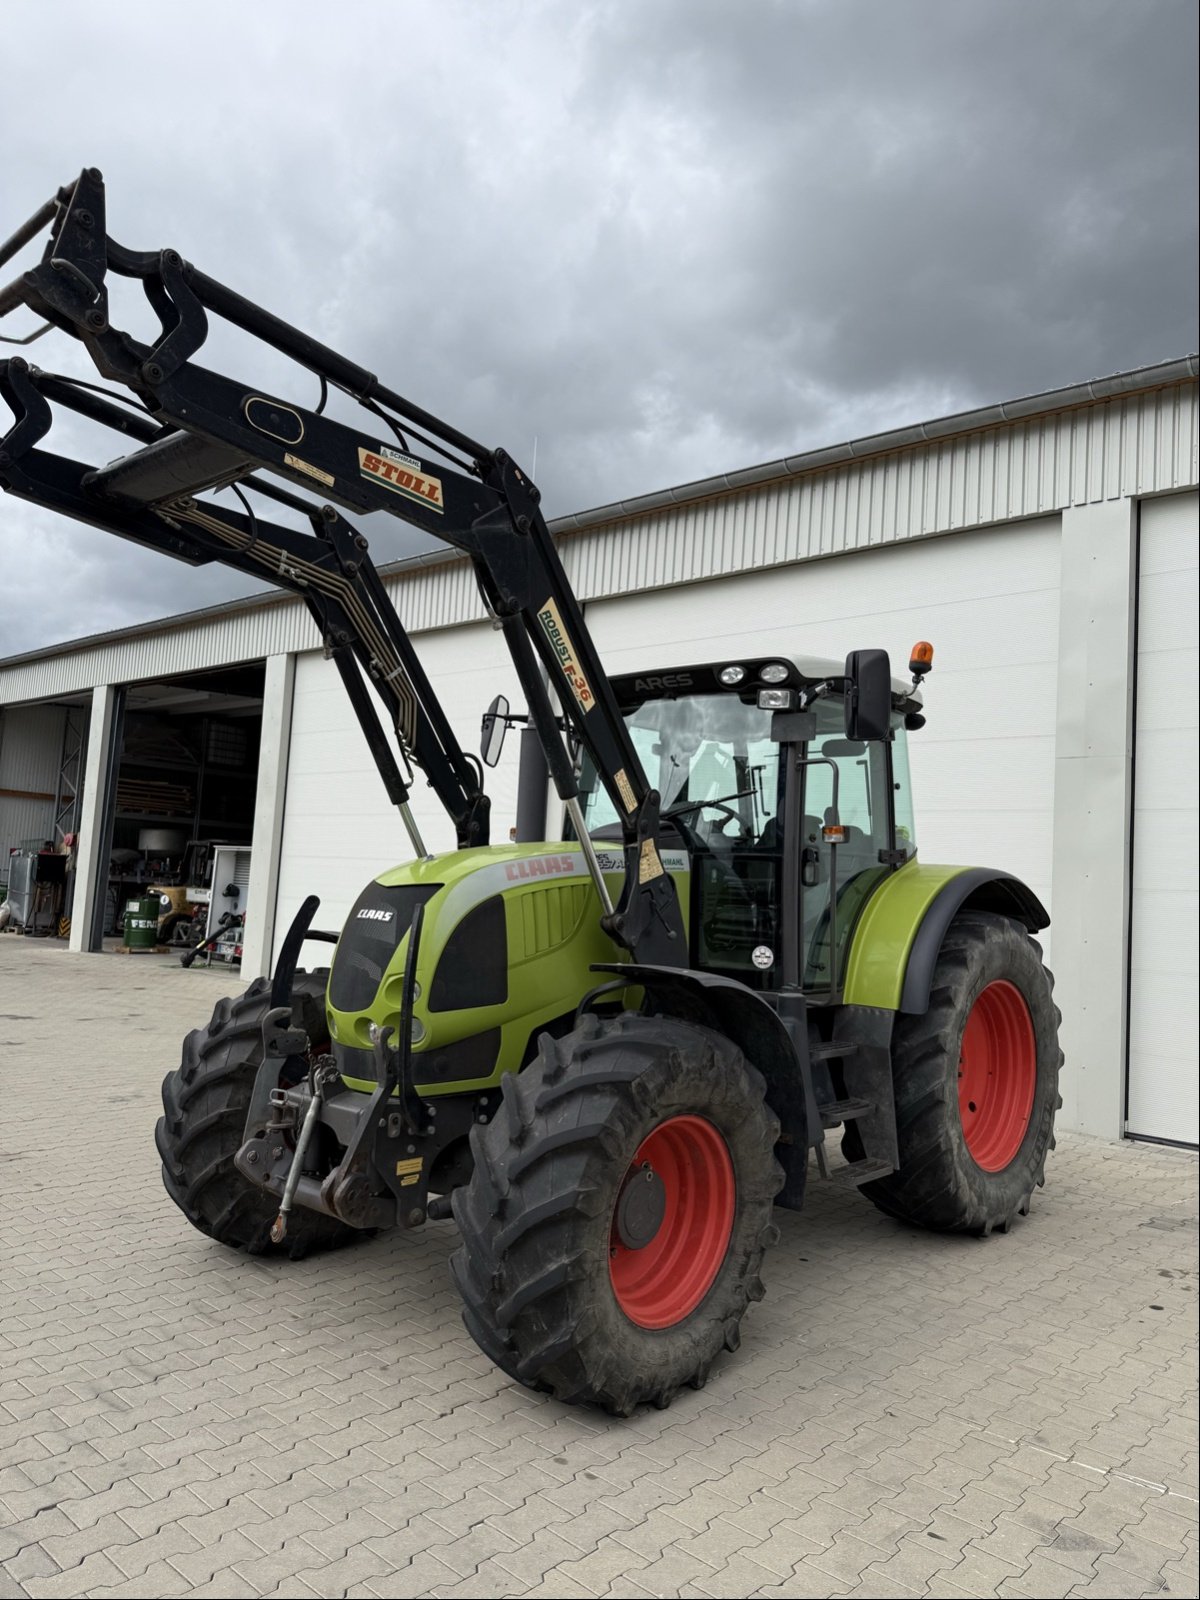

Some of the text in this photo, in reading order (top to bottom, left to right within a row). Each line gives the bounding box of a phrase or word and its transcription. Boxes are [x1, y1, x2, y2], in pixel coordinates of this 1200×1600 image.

[390, 451, 420, 468] SCHMAHL
[362, 453, 440, 503] STOLL
[541, 610, 573, 662] ROBUST
[634, 673, 694, 692] ARES
[505, 855, 575, 881] CLAAS
[661, 858, 684, 866] HMAHL
[357, 908, 394, 922] CLAAS
